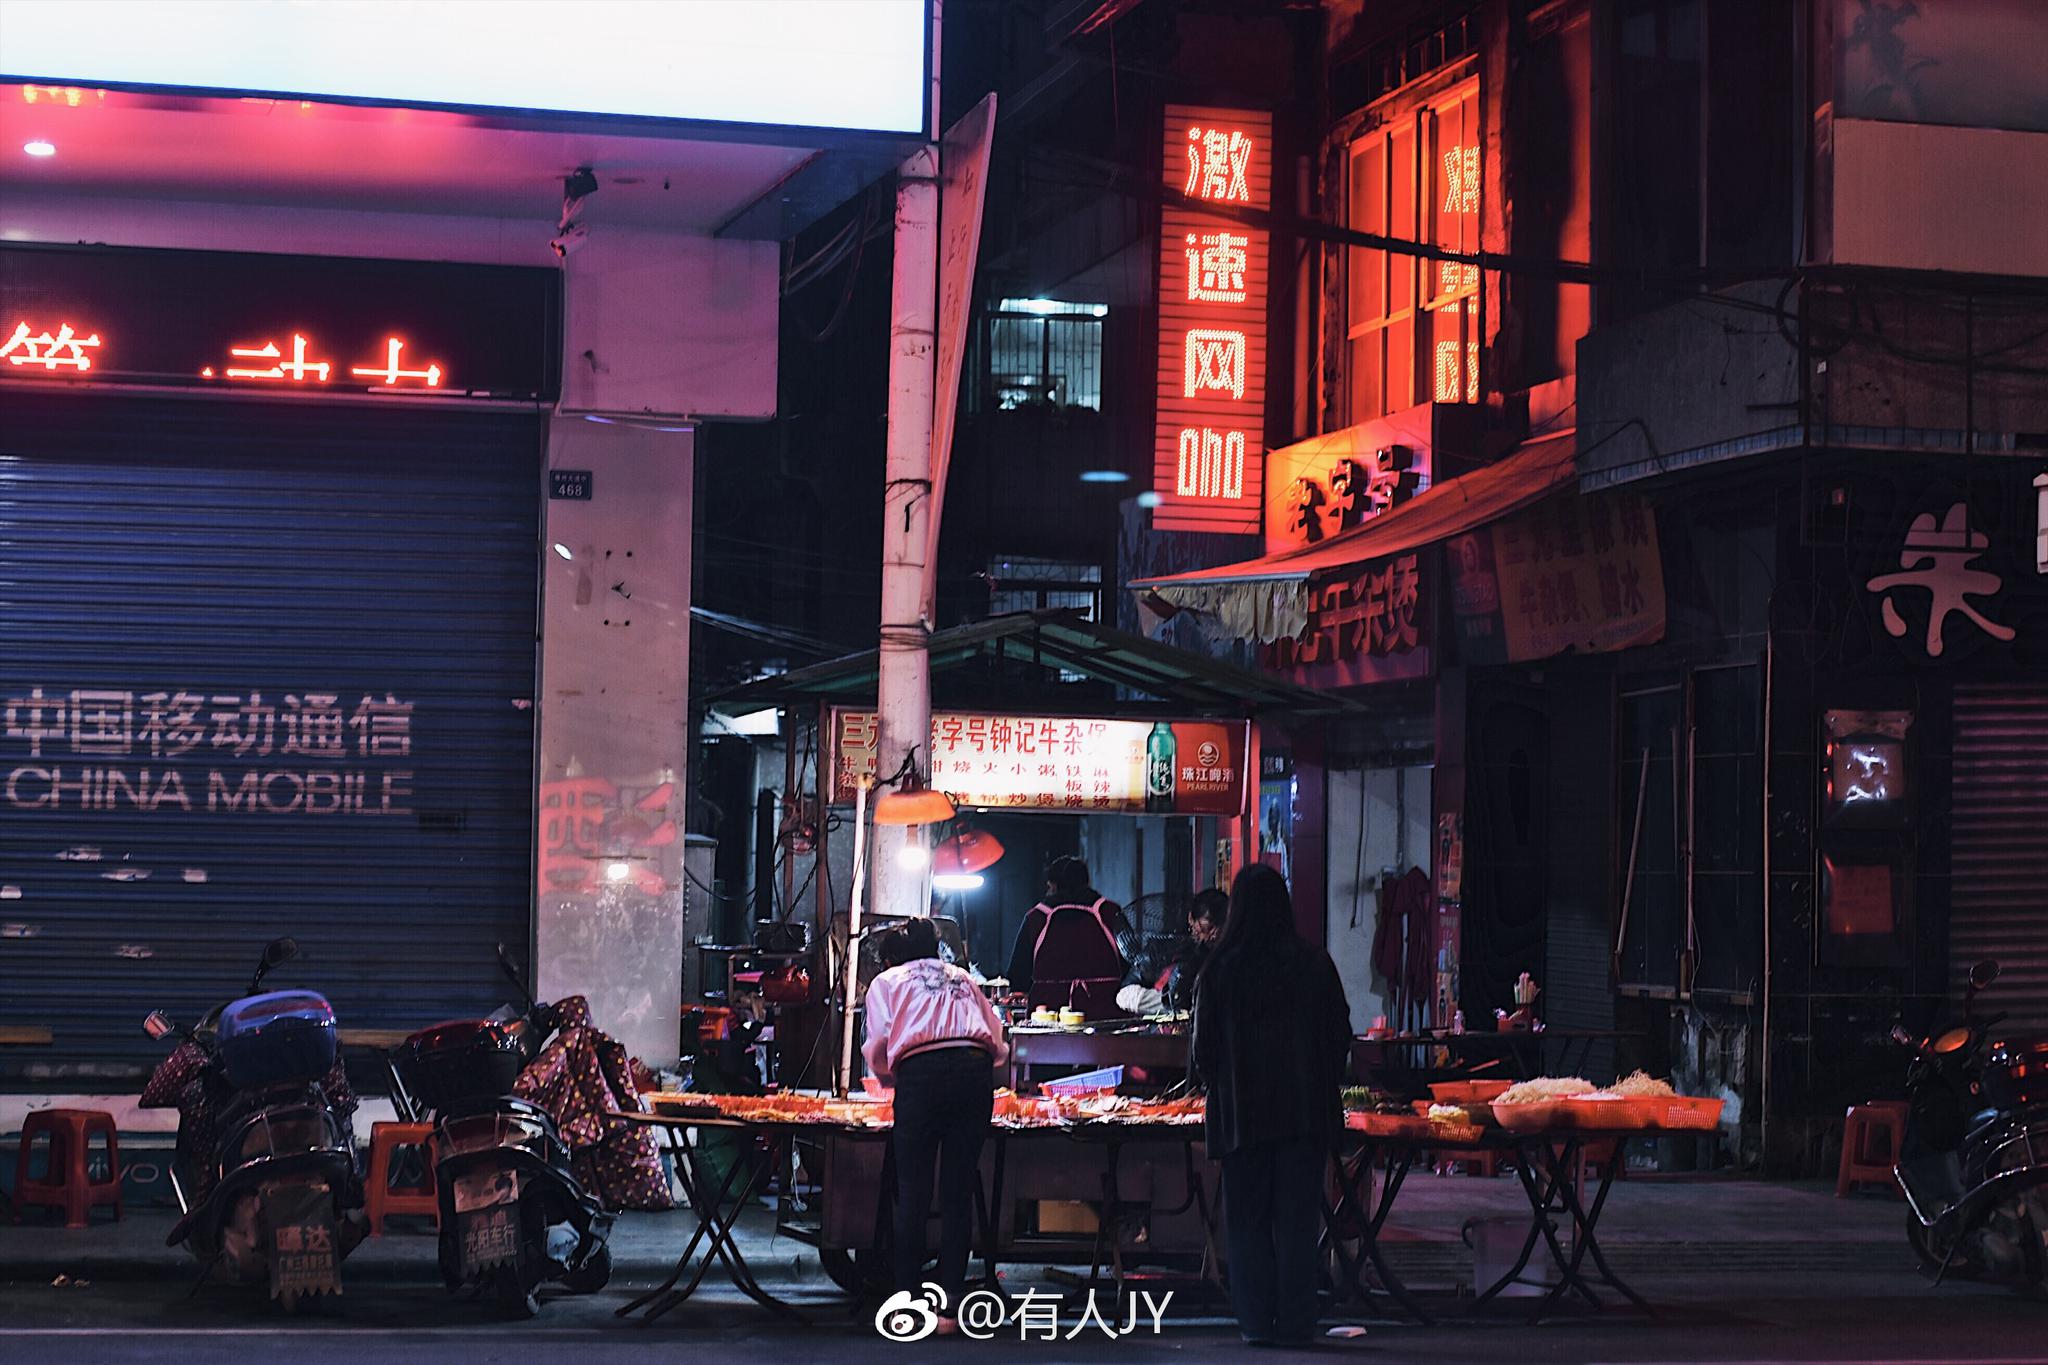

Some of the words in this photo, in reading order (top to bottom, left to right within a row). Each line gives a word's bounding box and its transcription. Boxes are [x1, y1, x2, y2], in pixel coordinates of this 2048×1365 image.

[1176, 126, 1252, 499] 激速网咖
[558, 483, 582, 497] 468
[1287, 445, 1412, 543] 老字号
[5, 688, 415, 758] 中国移动通信
[6, 767, 191, 812] CHINA
[208, 770, 414, 816] MOBILE
[1182, 766, 1235, 783] 珠江啤酒
[1186, 783, 1208, 791] PEARL
[1209, 783, 1230, 791] RIVER
